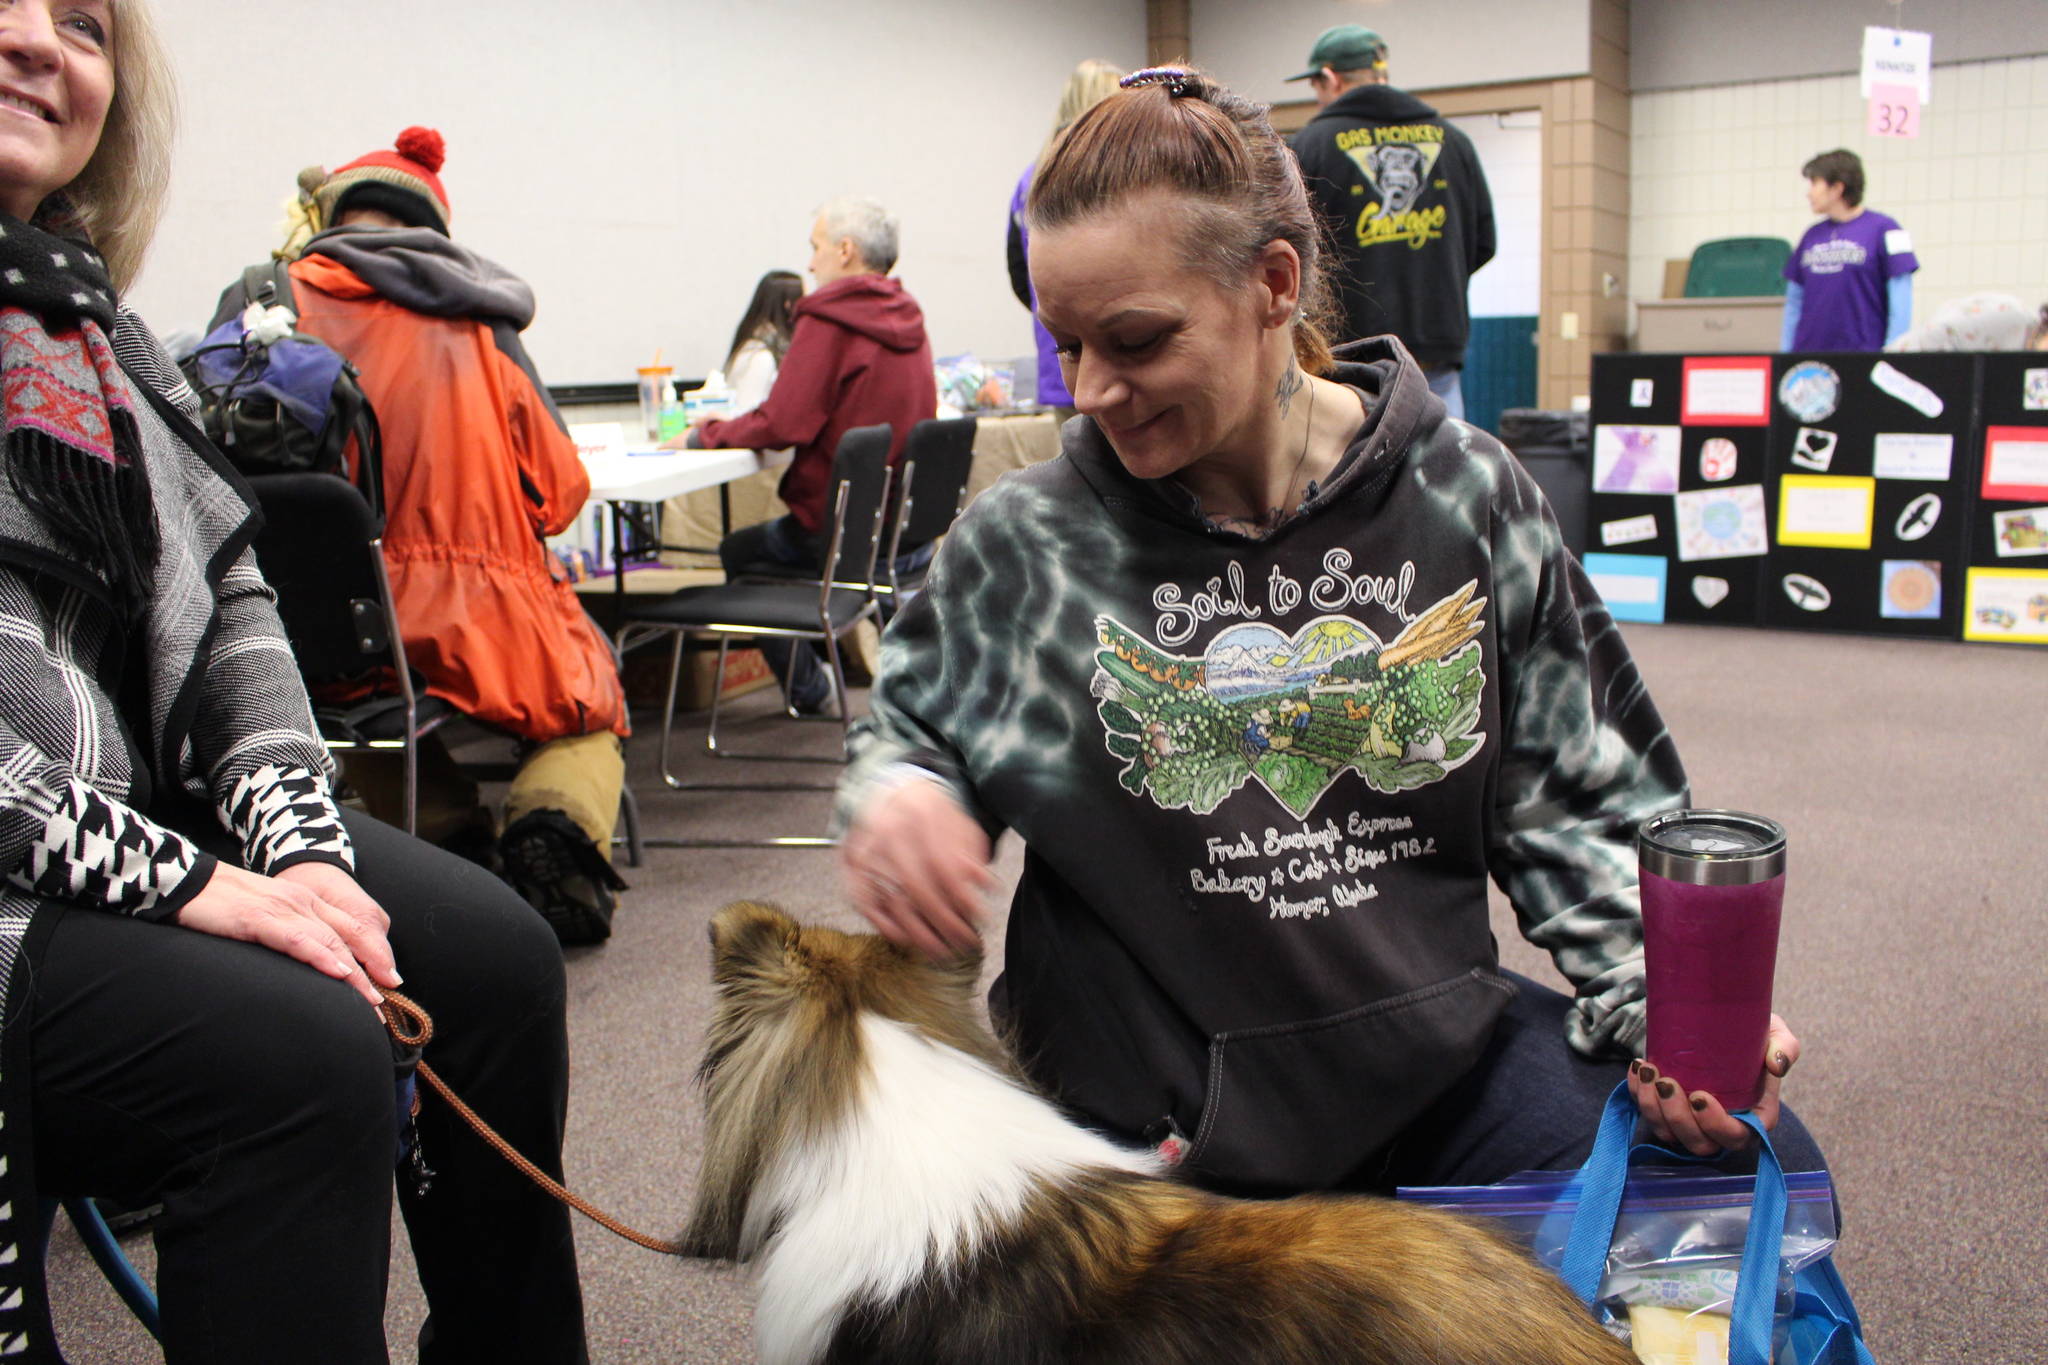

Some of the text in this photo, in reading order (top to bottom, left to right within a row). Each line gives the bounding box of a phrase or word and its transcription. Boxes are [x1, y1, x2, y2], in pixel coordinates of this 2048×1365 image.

[1335, 123, 1445, 152] GAS MONKEY
[1878, 103, 1909, 135] 32
[1355, 200, 1448, 250] Garage
[1152, 547, 1417, 647] Soil to Soul
[1206, 831, 1260, 865] Fresh
[1346, 810, 1413, 840] Express
[1190, 867, 1267, 903] Bakery
[1344, 844, 1388, 874] Since
[1391, 837, 1438, 861] 1982
